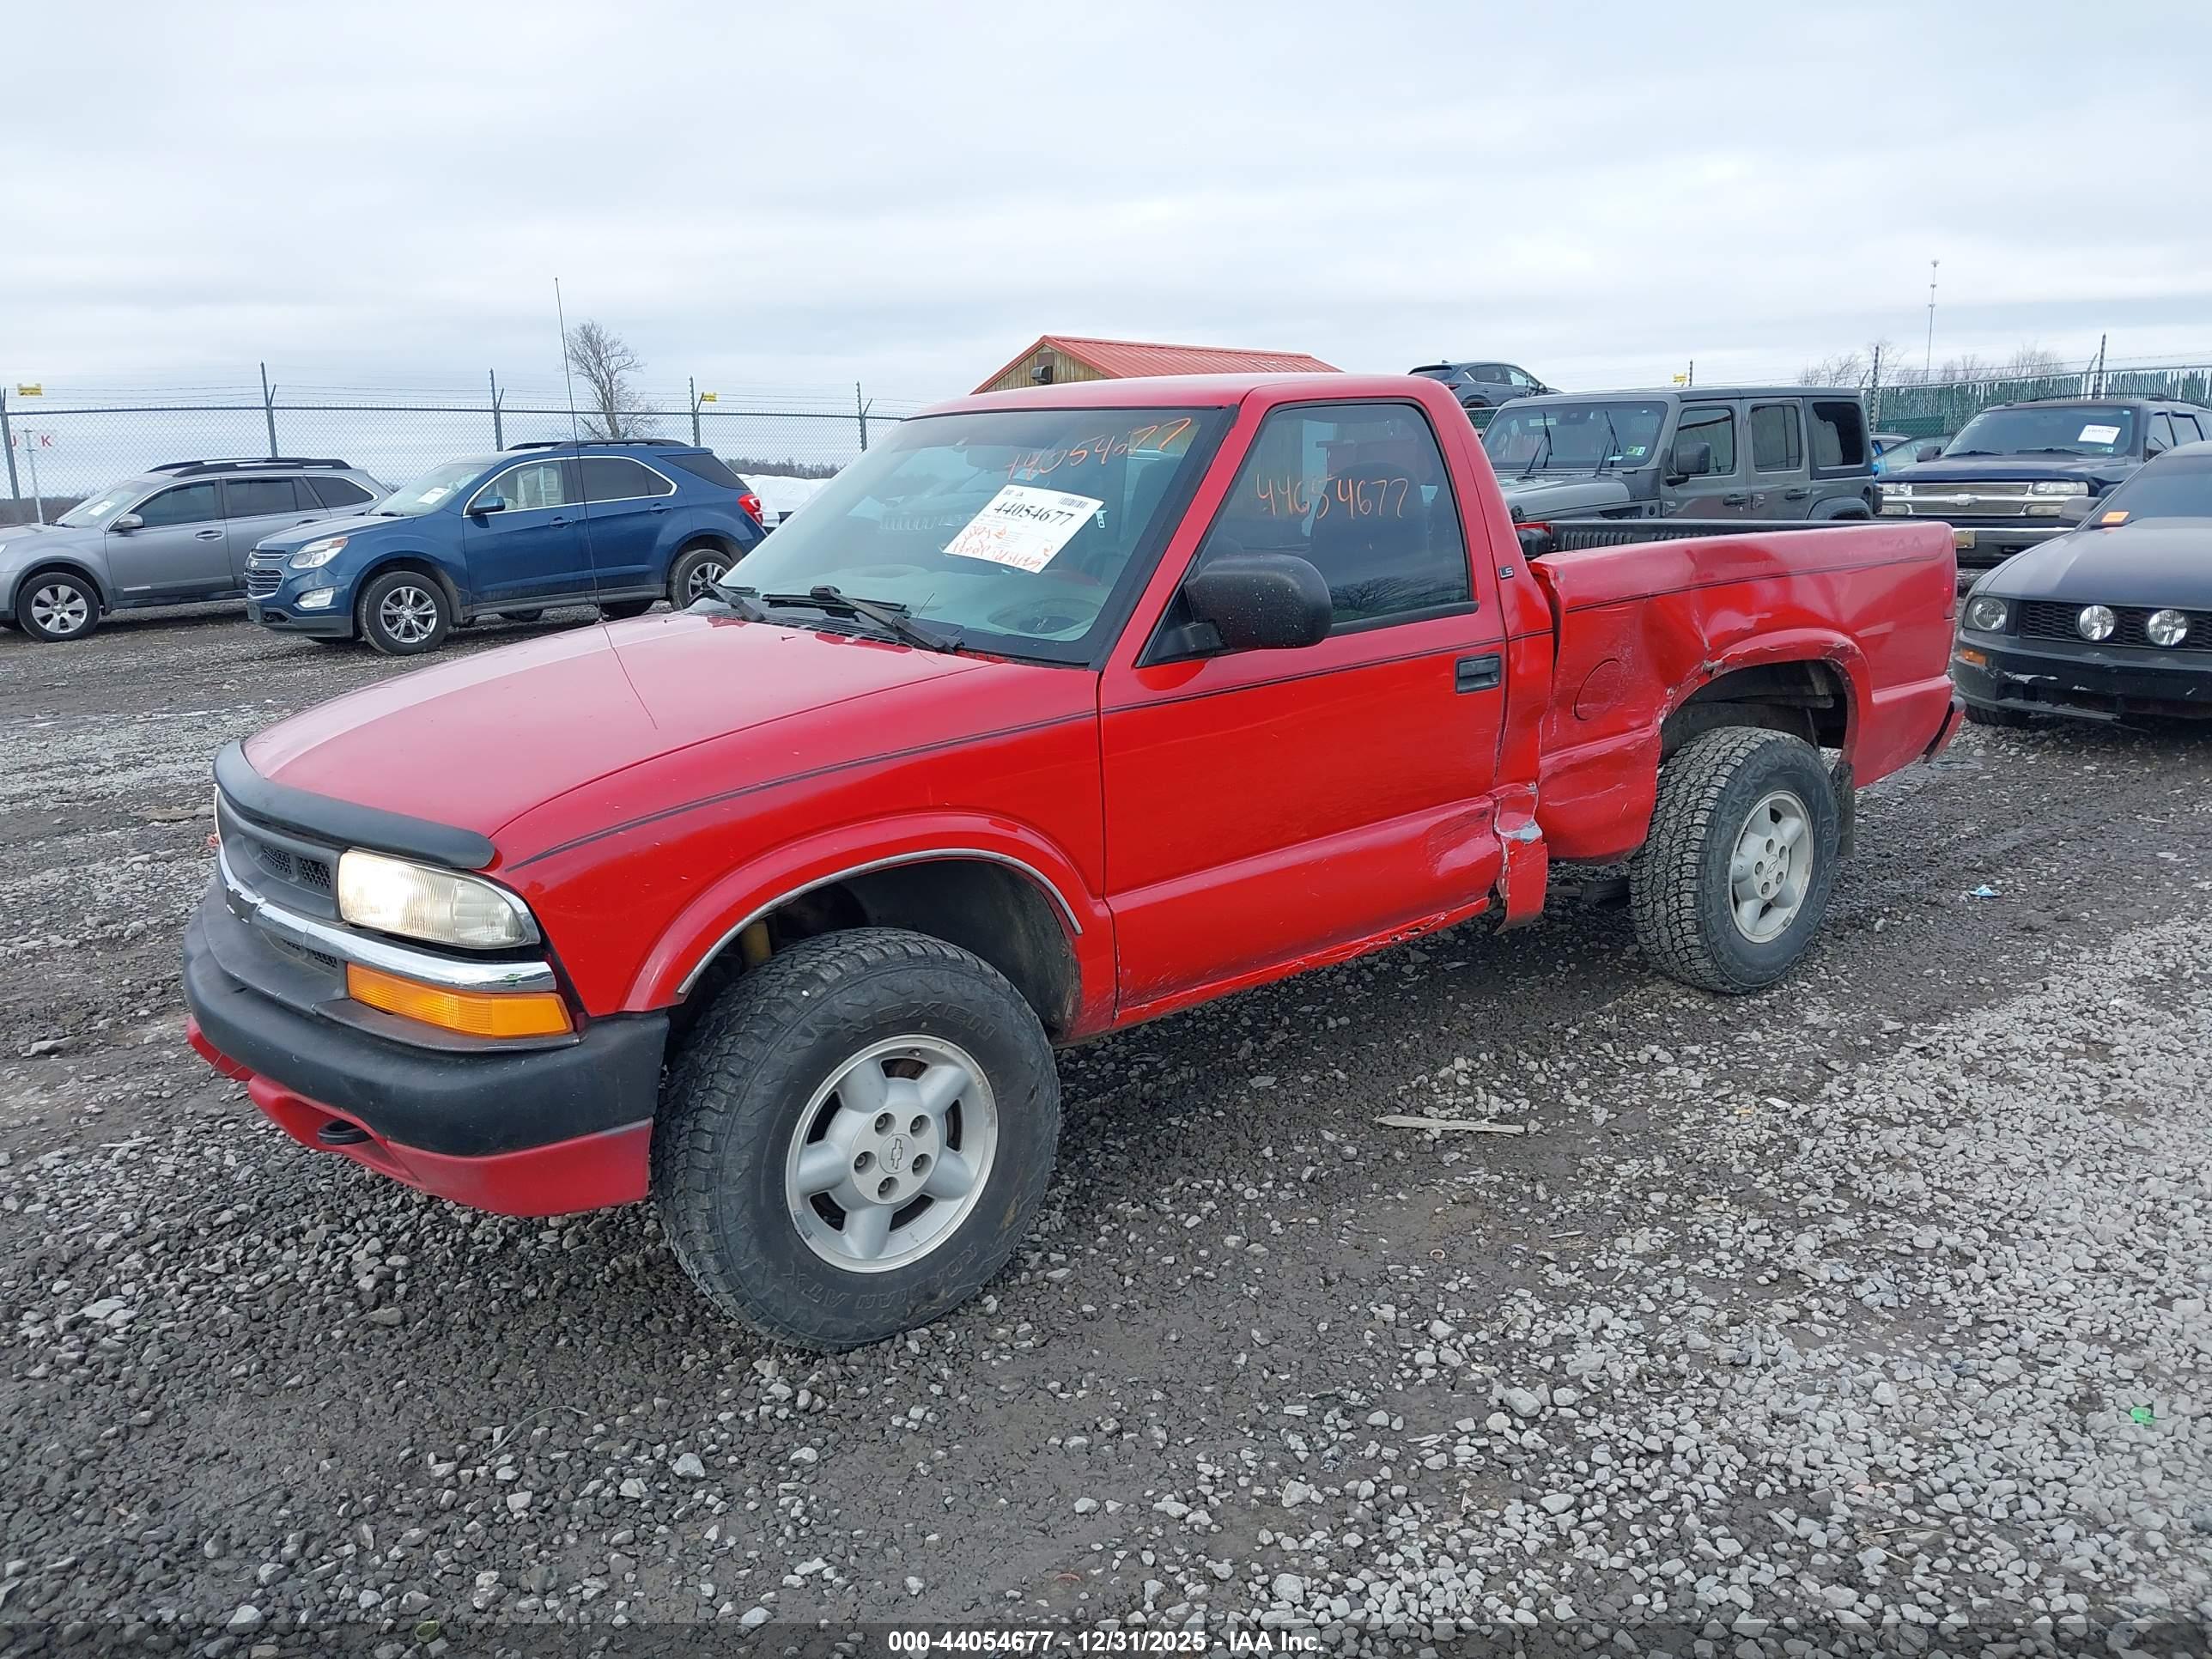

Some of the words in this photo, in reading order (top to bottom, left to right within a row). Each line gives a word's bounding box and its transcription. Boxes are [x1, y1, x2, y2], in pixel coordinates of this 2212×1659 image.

[40, 434, 52, 447] K
[994, 501, 1077, 526] 44054677
[1499, 567, 1514, 579] LS
[843, 1000, 998, 1045] NEXEN
[782, 1260, 851, 1308] ATX
